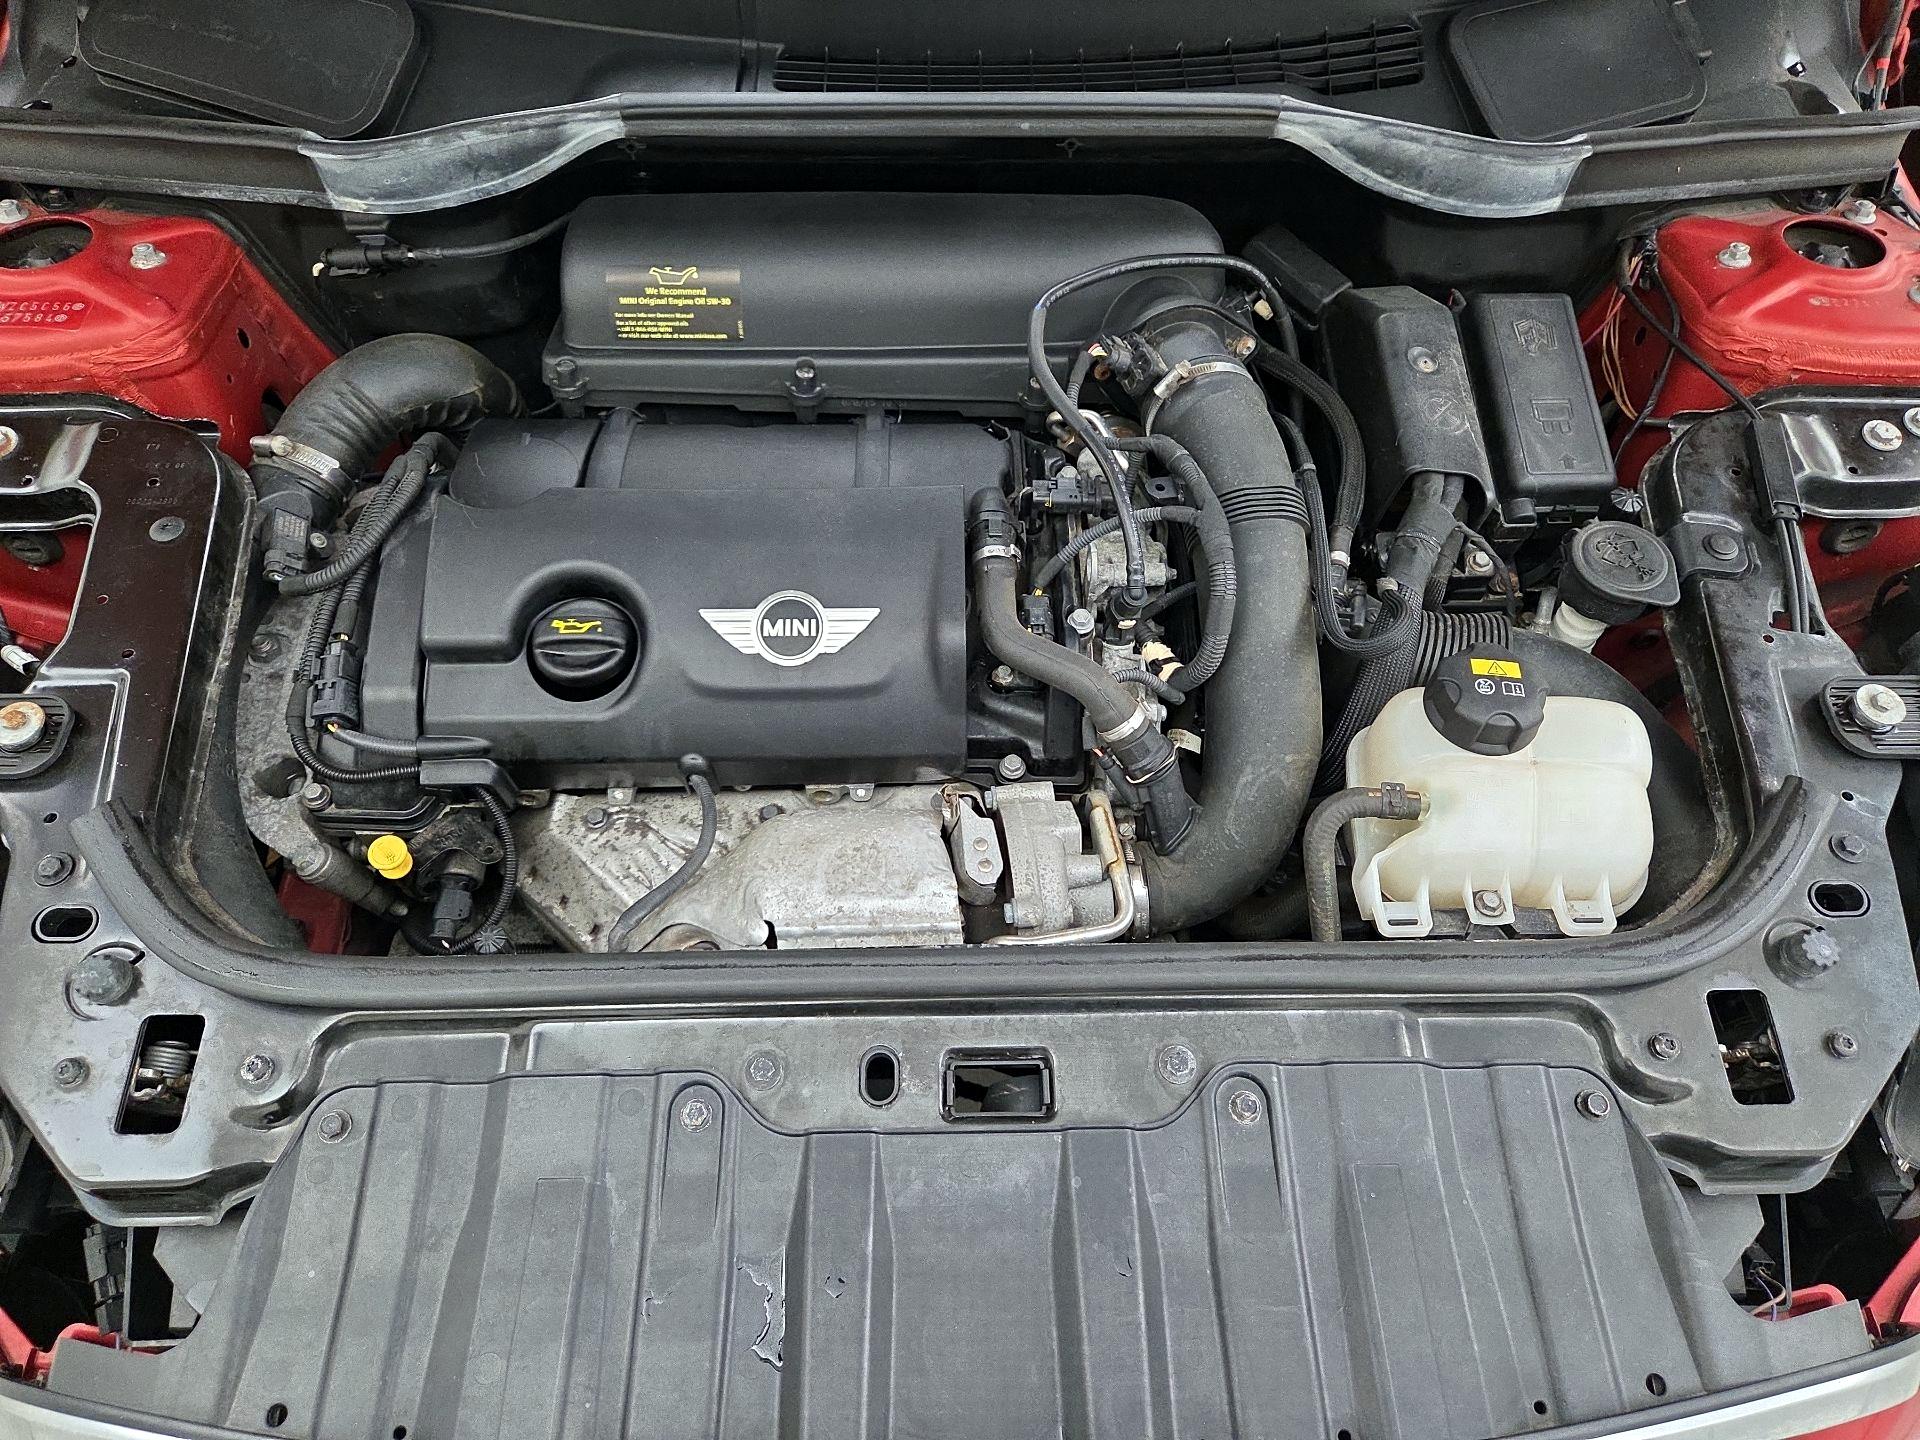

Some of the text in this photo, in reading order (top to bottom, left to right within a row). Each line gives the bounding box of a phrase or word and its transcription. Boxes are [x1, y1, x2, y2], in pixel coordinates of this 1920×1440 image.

[659, 287, 707, 295] Recommend
[638, 297, 668, 306] Original
[668, 297, 694, 306] Engine
[694, 297, 706, 305] Oil
[706, 297, 732, 305] 5W-30
[763, 618, 817, 637] MINI
